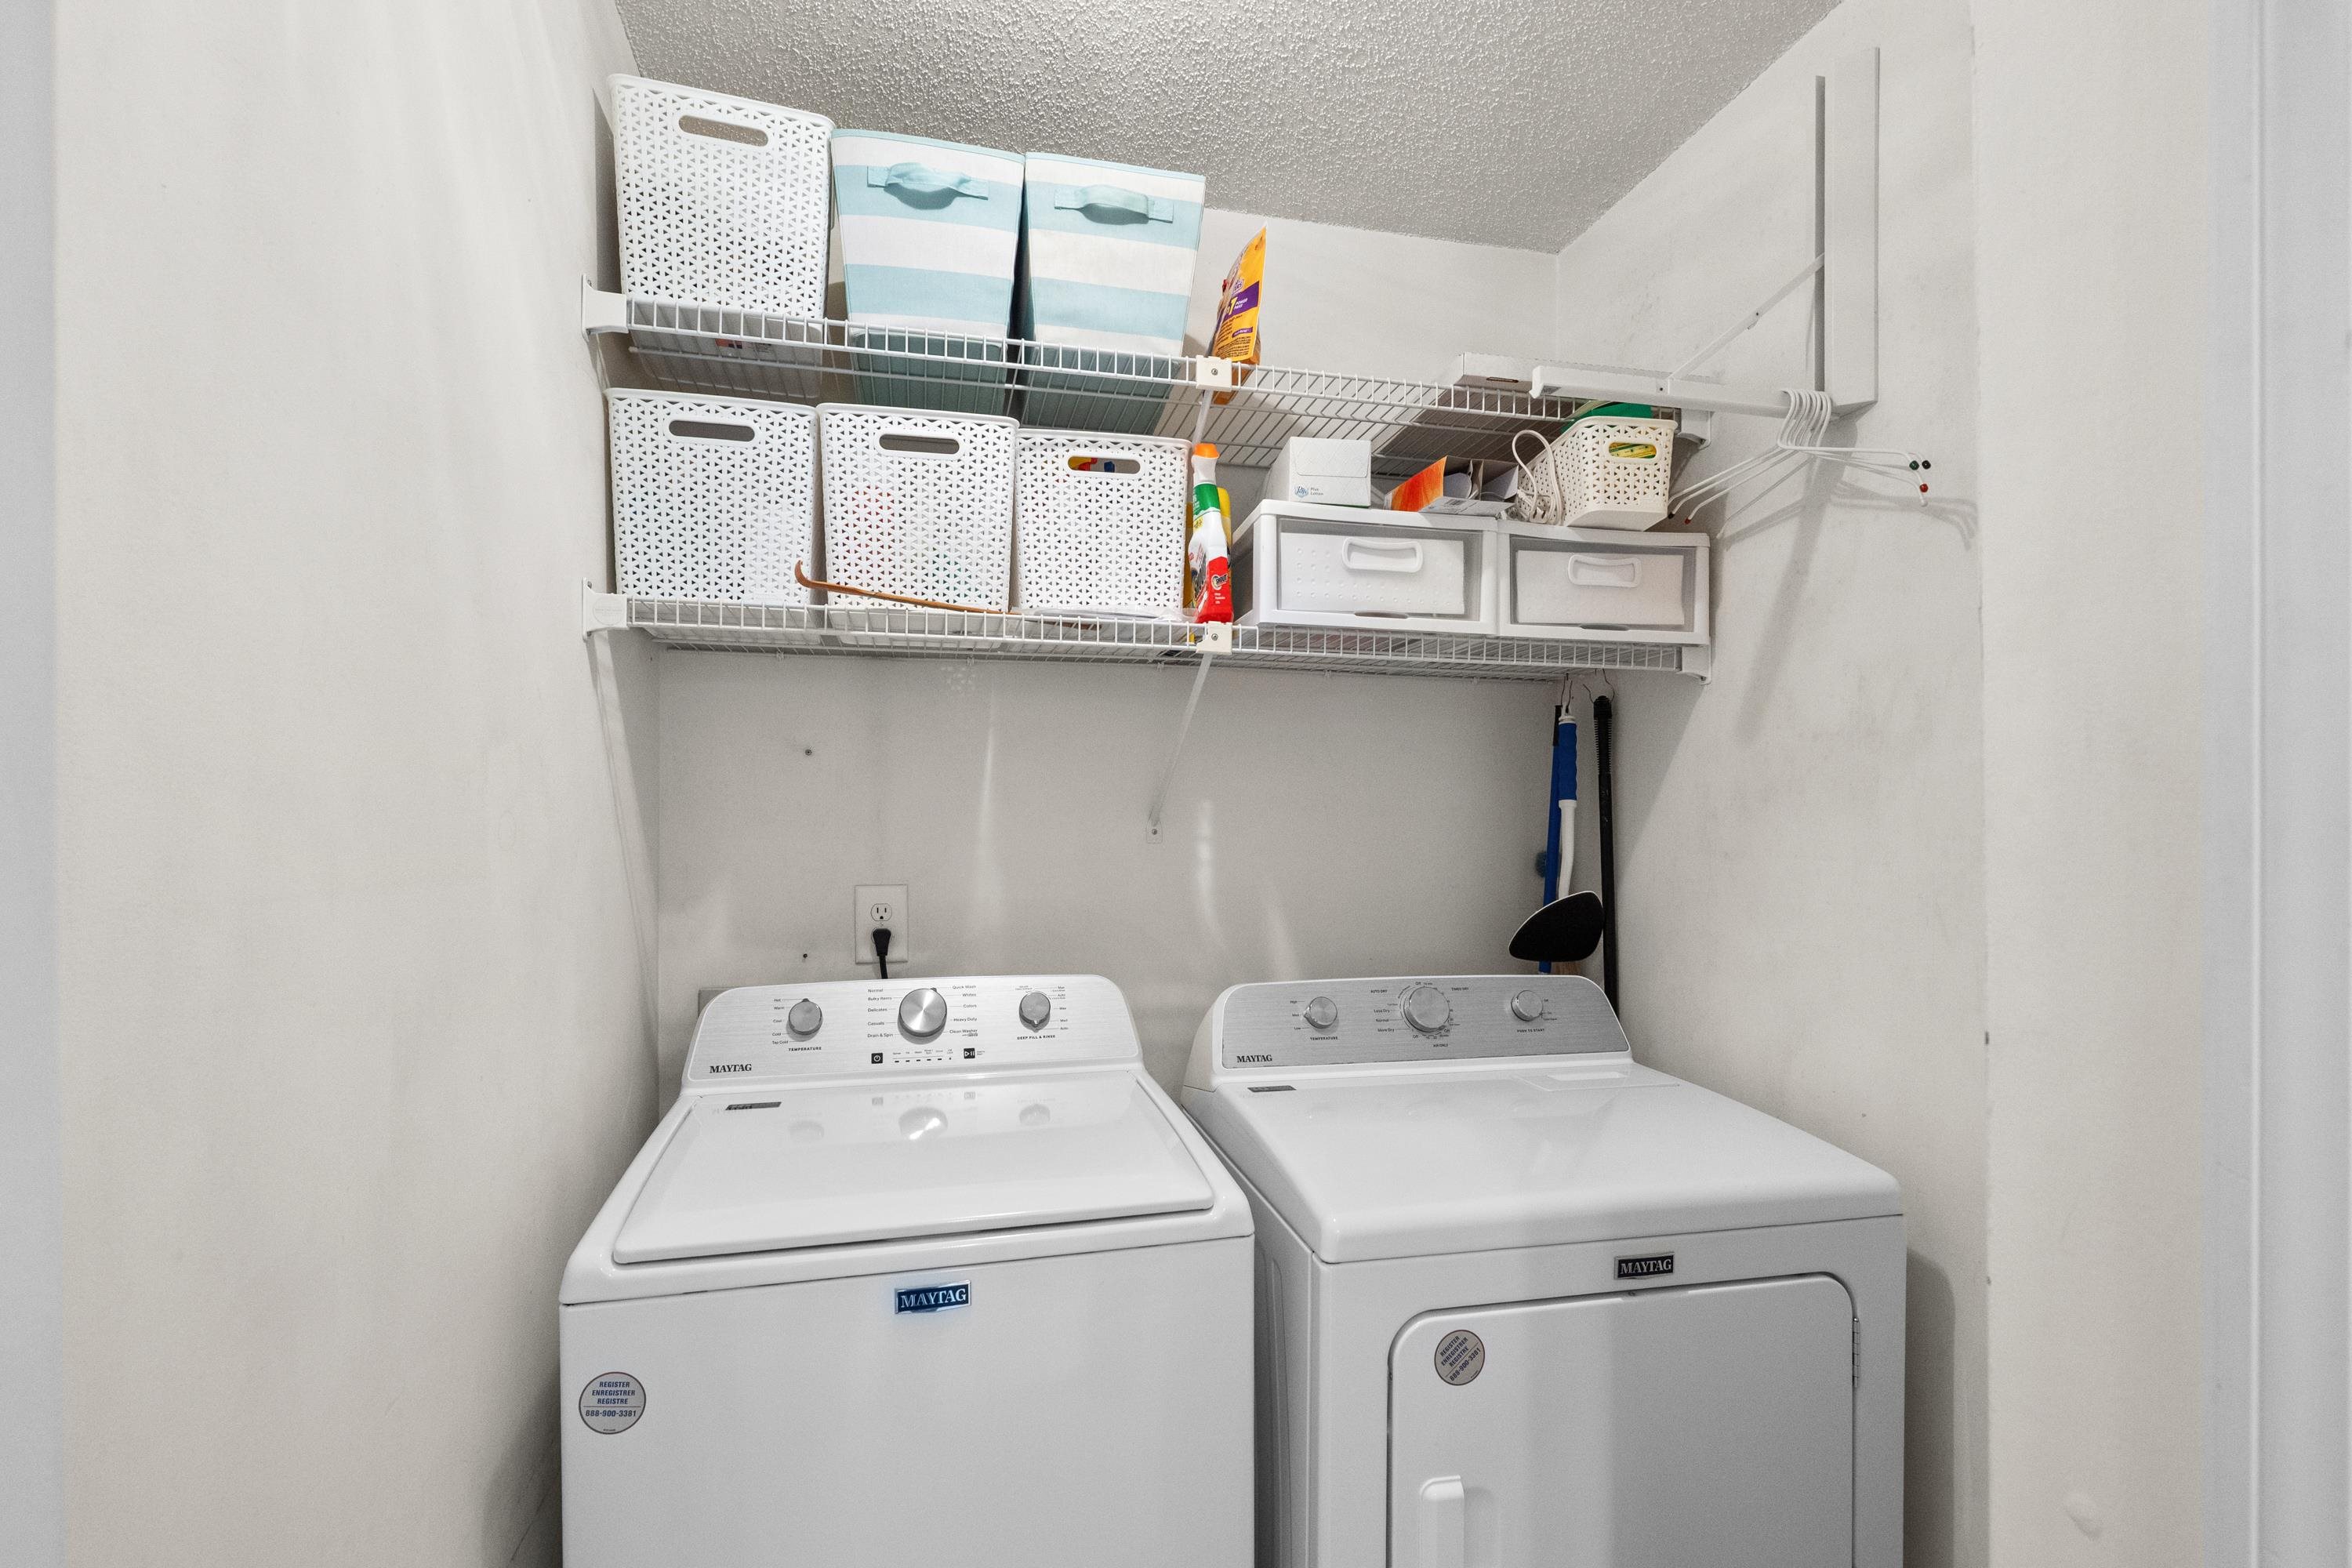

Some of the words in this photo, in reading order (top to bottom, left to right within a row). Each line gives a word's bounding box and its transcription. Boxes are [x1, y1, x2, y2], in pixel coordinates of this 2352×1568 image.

[710, 1063, 753, 1073] MAYTAG
[1236, 1054, 1273, 1063] MAYTAG
[1620, 1258, 1671, 1275] MAYTAG
[900, 1288, 967, 1308] MAYTAG
[1440, 1335, 1460, 1356] REGISTER
[1441, 1337, 1468, 1367] ENREGISTRER
[1449, 1345, 1468, 1367] REGISTRE
[1450, 1347, 1481, 1381] 888-900-3381
